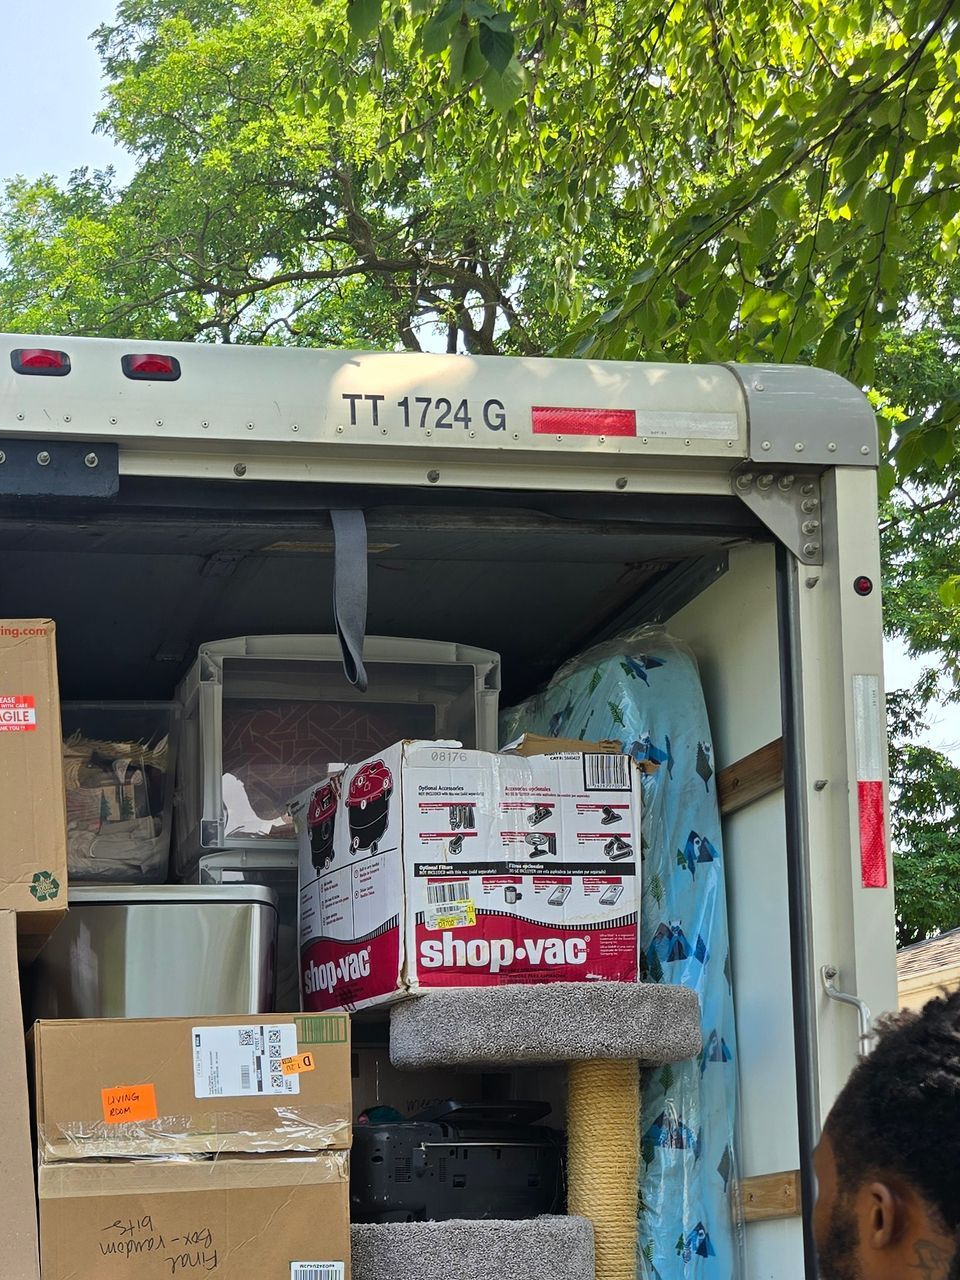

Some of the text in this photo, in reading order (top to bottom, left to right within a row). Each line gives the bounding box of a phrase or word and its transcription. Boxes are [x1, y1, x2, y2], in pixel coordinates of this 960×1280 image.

[342, 393, 507, 432] TT 1724 G
[431, 751, 468, 762] 08176
[107, 1093, 140, 1106] LIVING
[163, 1250, 218, 1274] Final
